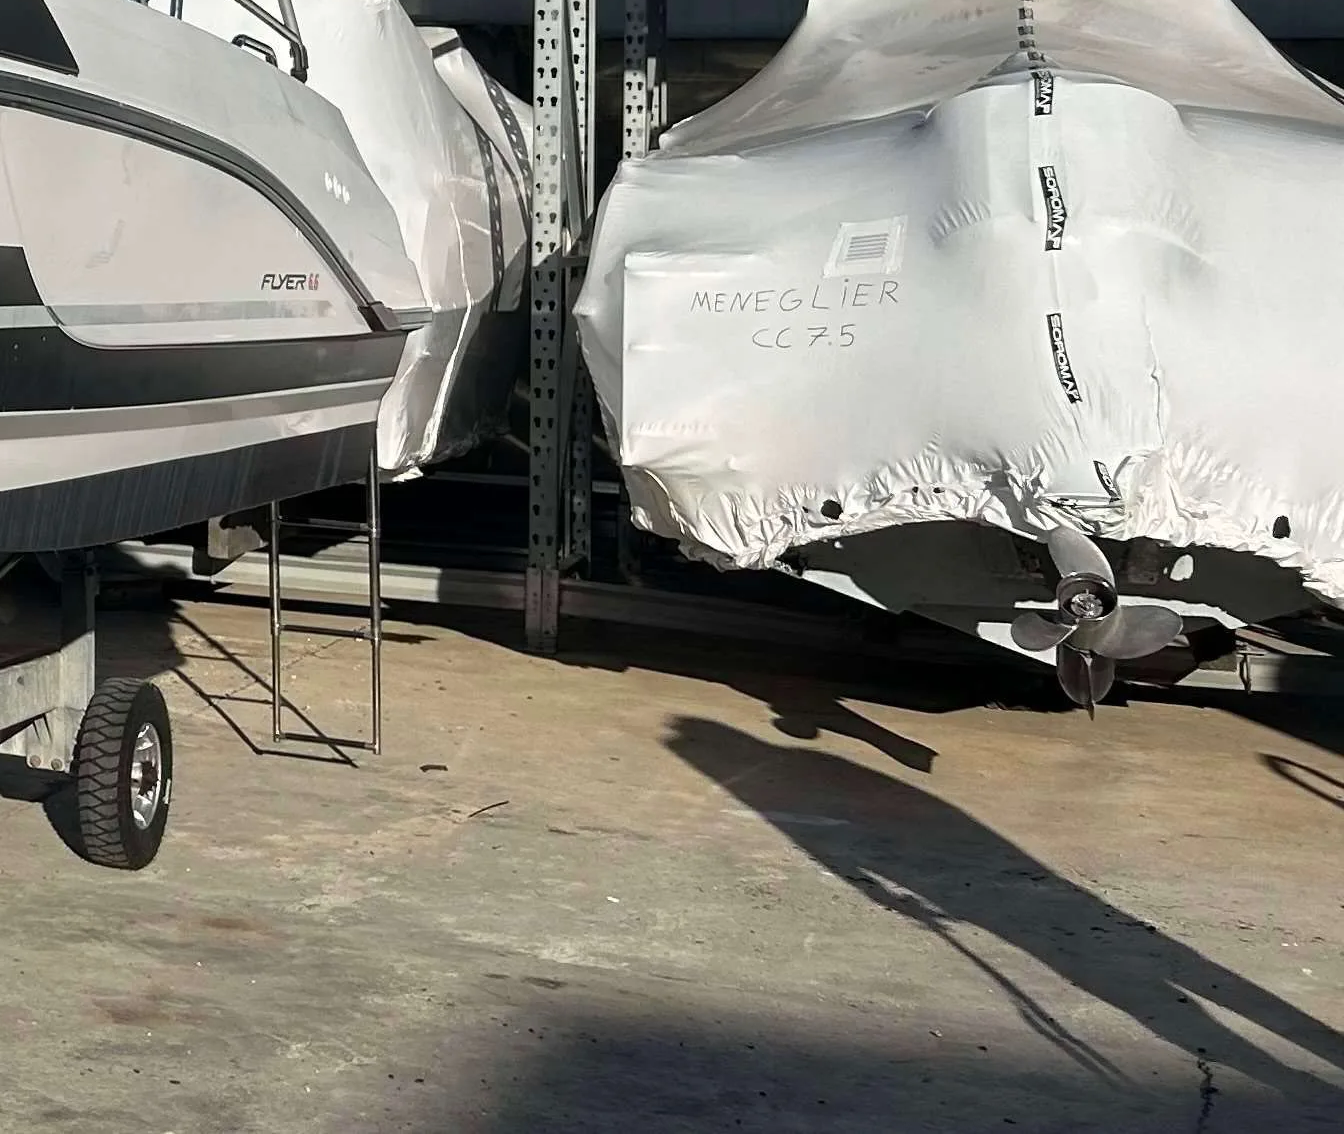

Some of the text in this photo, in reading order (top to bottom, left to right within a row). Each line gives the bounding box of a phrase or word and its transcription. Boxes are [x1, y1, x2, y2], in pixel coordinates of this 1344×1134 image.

[261, 274, 306, 290] FLYER
[751, 323, 857, 349] CC 7.5
